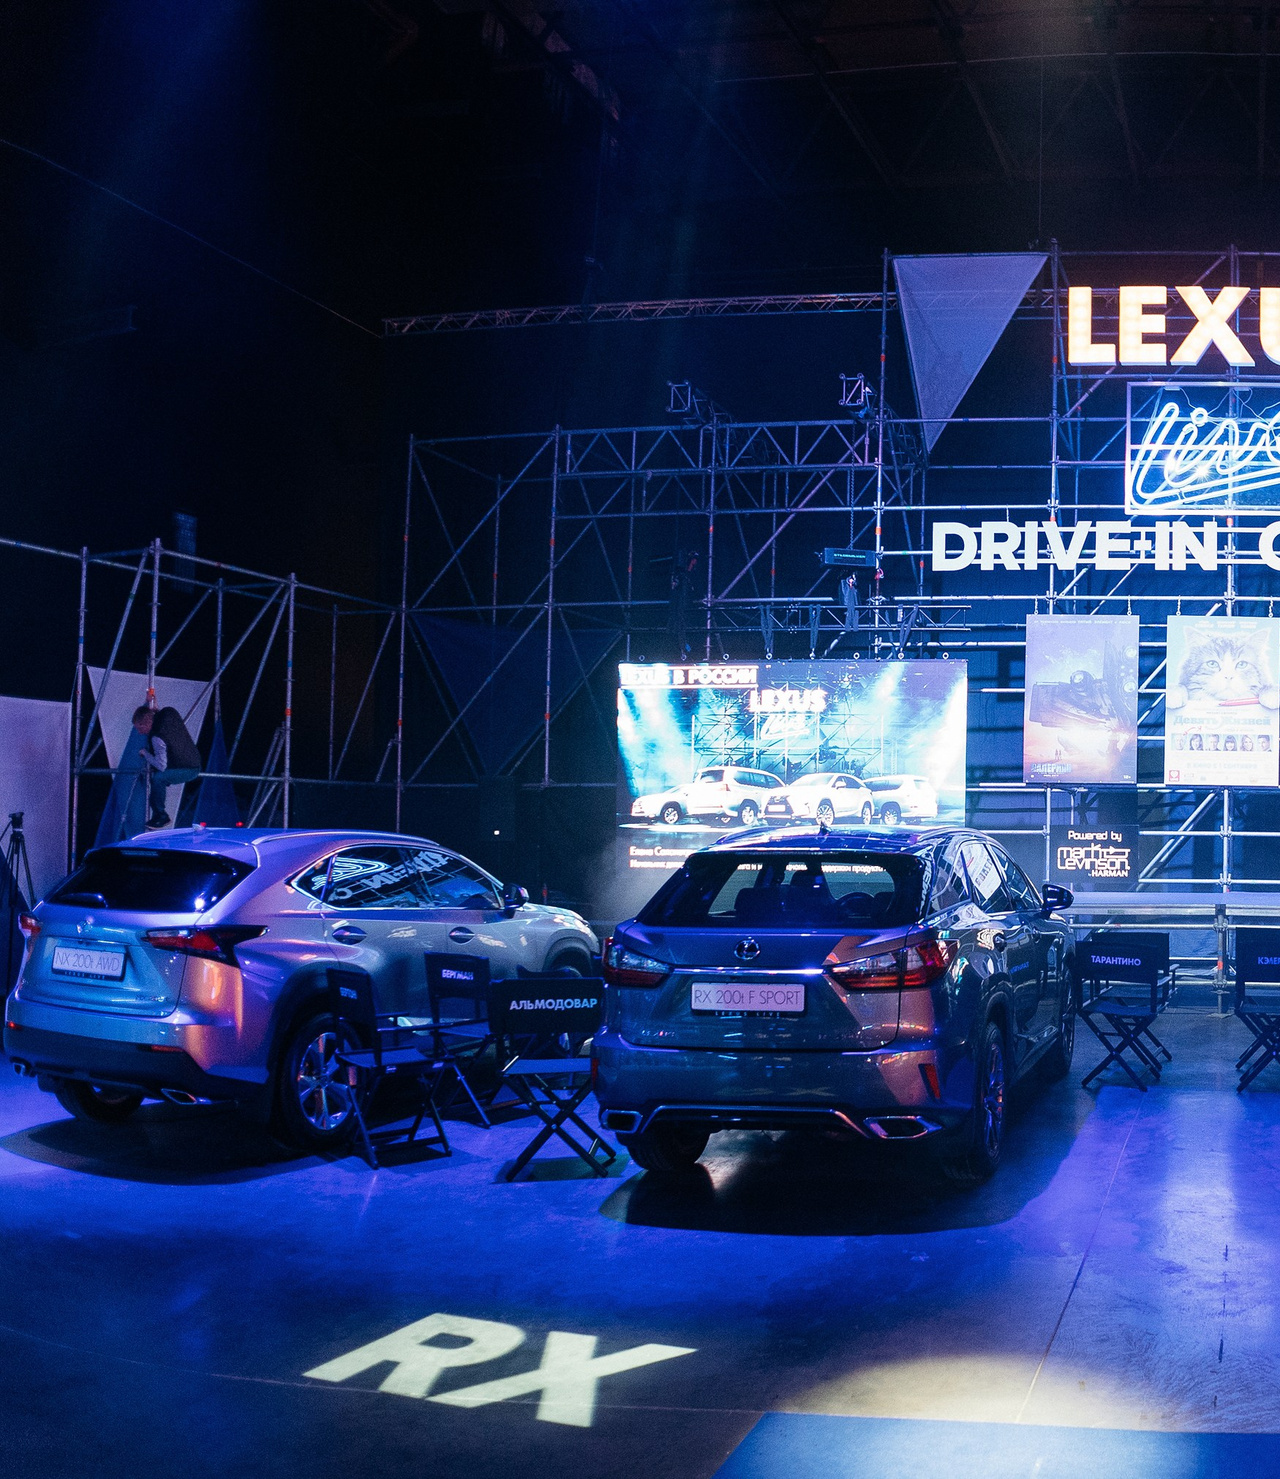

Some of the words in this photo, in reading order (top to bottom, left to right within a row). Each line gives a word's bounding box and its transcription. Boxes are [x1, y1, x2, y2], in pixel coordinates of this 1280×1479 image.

[931, 520, 1218, 572] DRIVE-IN
[688, 669, 757, 684] РОССИИ
[750, 689, 827, 712] LEXUS
[1068, 830, 1108, 840] Powered
[1110, 830, 1122, 842] by
[55, 952, 71, 966] NX
[72, 954, 94, 969] 200t
[95, 957, 120, 972] AWD
[1091, 955, 1142, 967] ТАРАНТИНО
[442, 969, 474, 980] БЕРГМАН
[509, 998, 598, 1011] АЛЬМОДОВАР
[694, 990, 712, 1004] RX
[716, 989, 744, 1005] 200t
[748, 990, 755, 1004] F
[759, 990, 801, 1005] SPORT
[300, 1312, 699, 1427] RX
